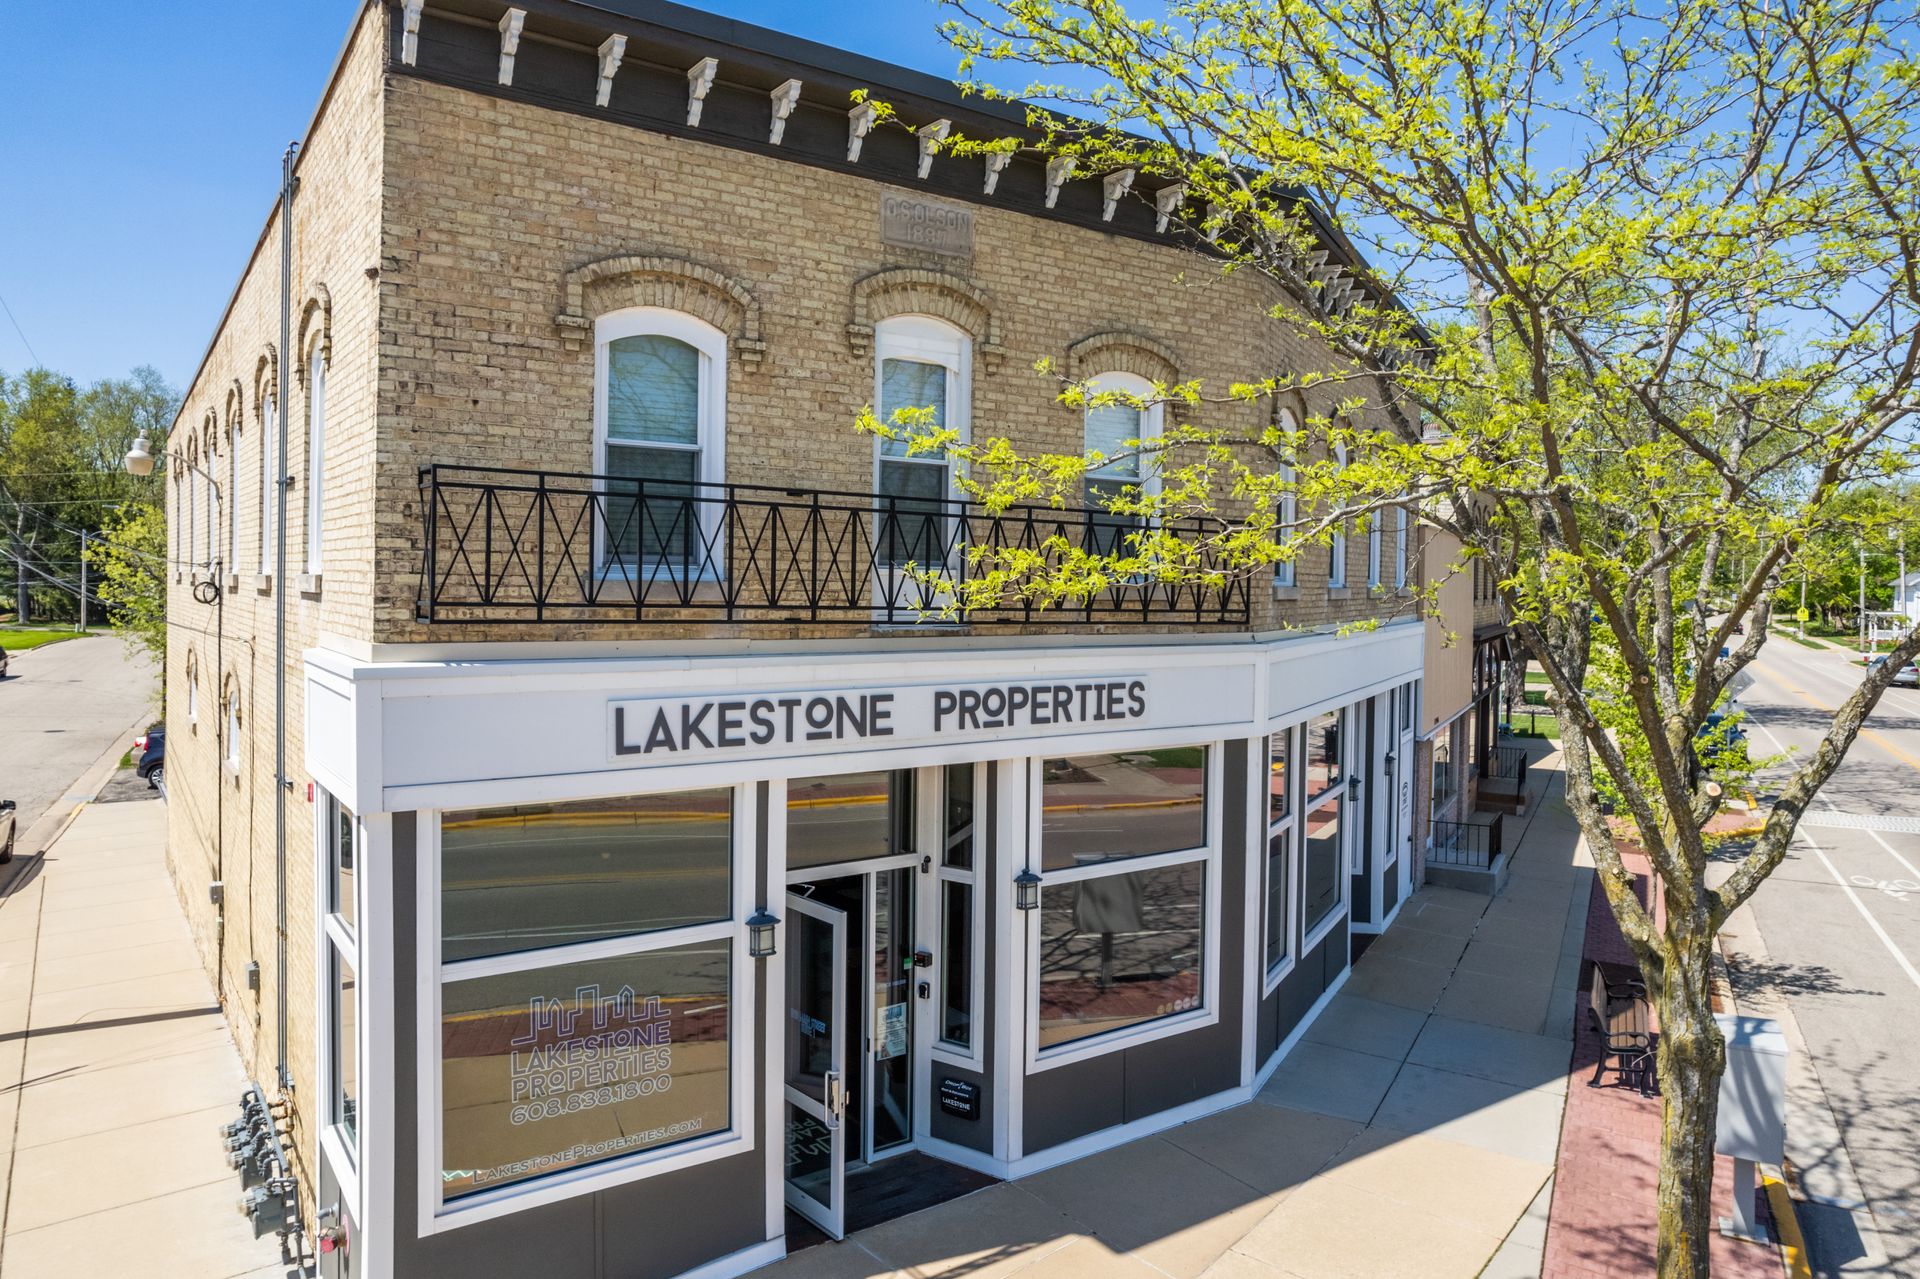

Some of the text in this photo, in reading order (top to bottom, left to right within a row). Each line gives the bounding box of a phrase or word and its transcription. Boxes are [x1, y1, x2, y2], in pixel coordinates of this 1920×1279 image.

[615, 680, 1147, 756] LAKESTONE PROPERTIES
[511, 1021, 672, 1077] LAKESTONE
[511, 1047, 672, 1103] PROPERTIES
[510, 1074, 672, 1126] 608.838.1800
